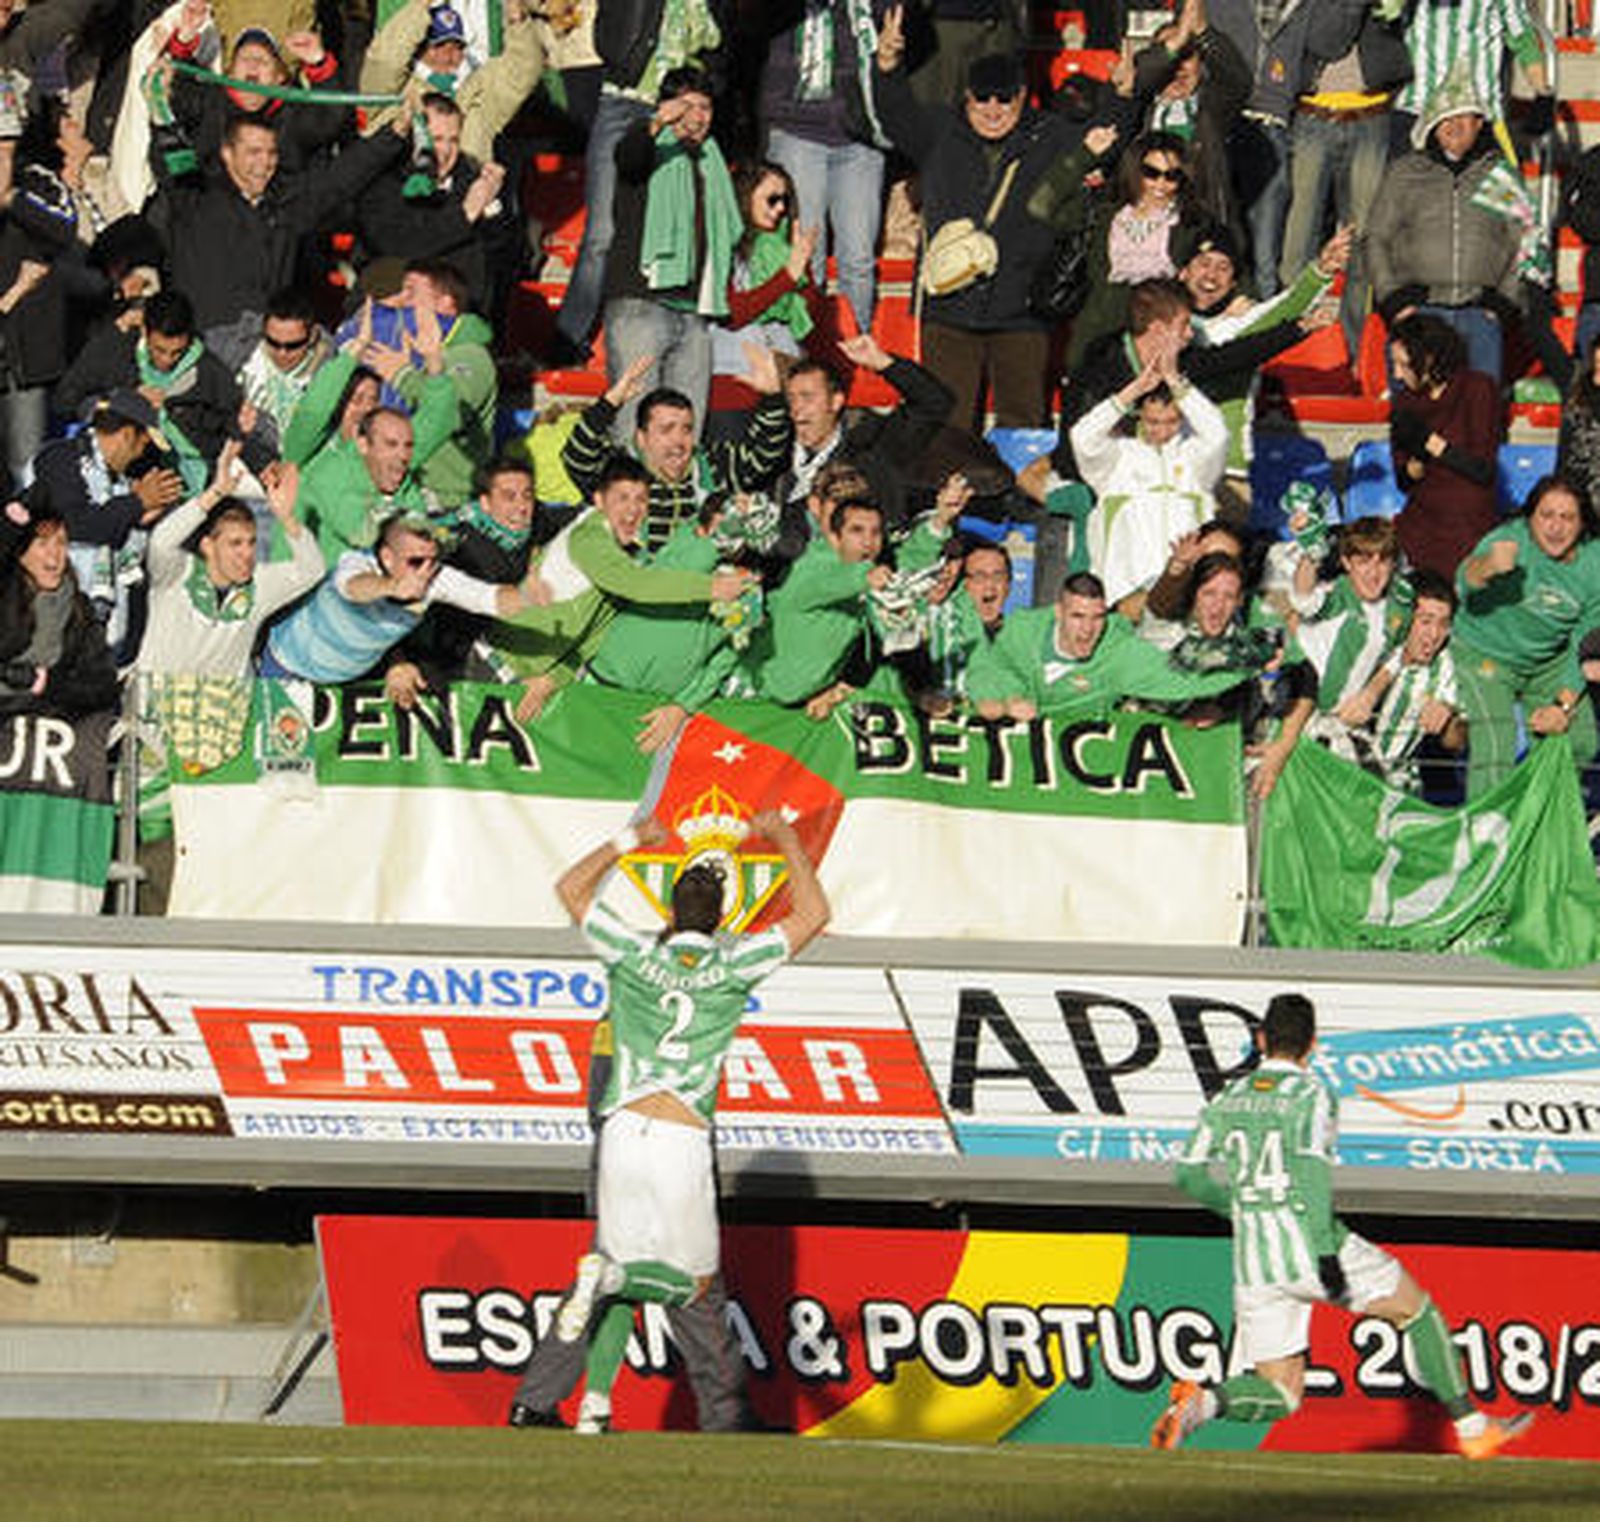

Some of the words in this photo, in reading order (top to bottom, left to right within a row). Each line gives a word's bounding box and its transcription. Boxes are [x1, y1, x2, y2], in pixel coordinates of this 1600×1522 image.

[656, 991, 694, 1060] 2
[247, 1022, 882, 1102] PALOAR
[0, 1095, 215, 1127] oria.com
[714, 1127, 945, 1149] ONTENEDORES
[1224, 1131, 1290, 1202] 24
[1407, 1138, 1565, 1175] SORIA
[789, 1300, 844, 1378] &
[862, 1301, 1340, 1387] PORTUG
[1354, 1318, 1600, 1402] 218/2
